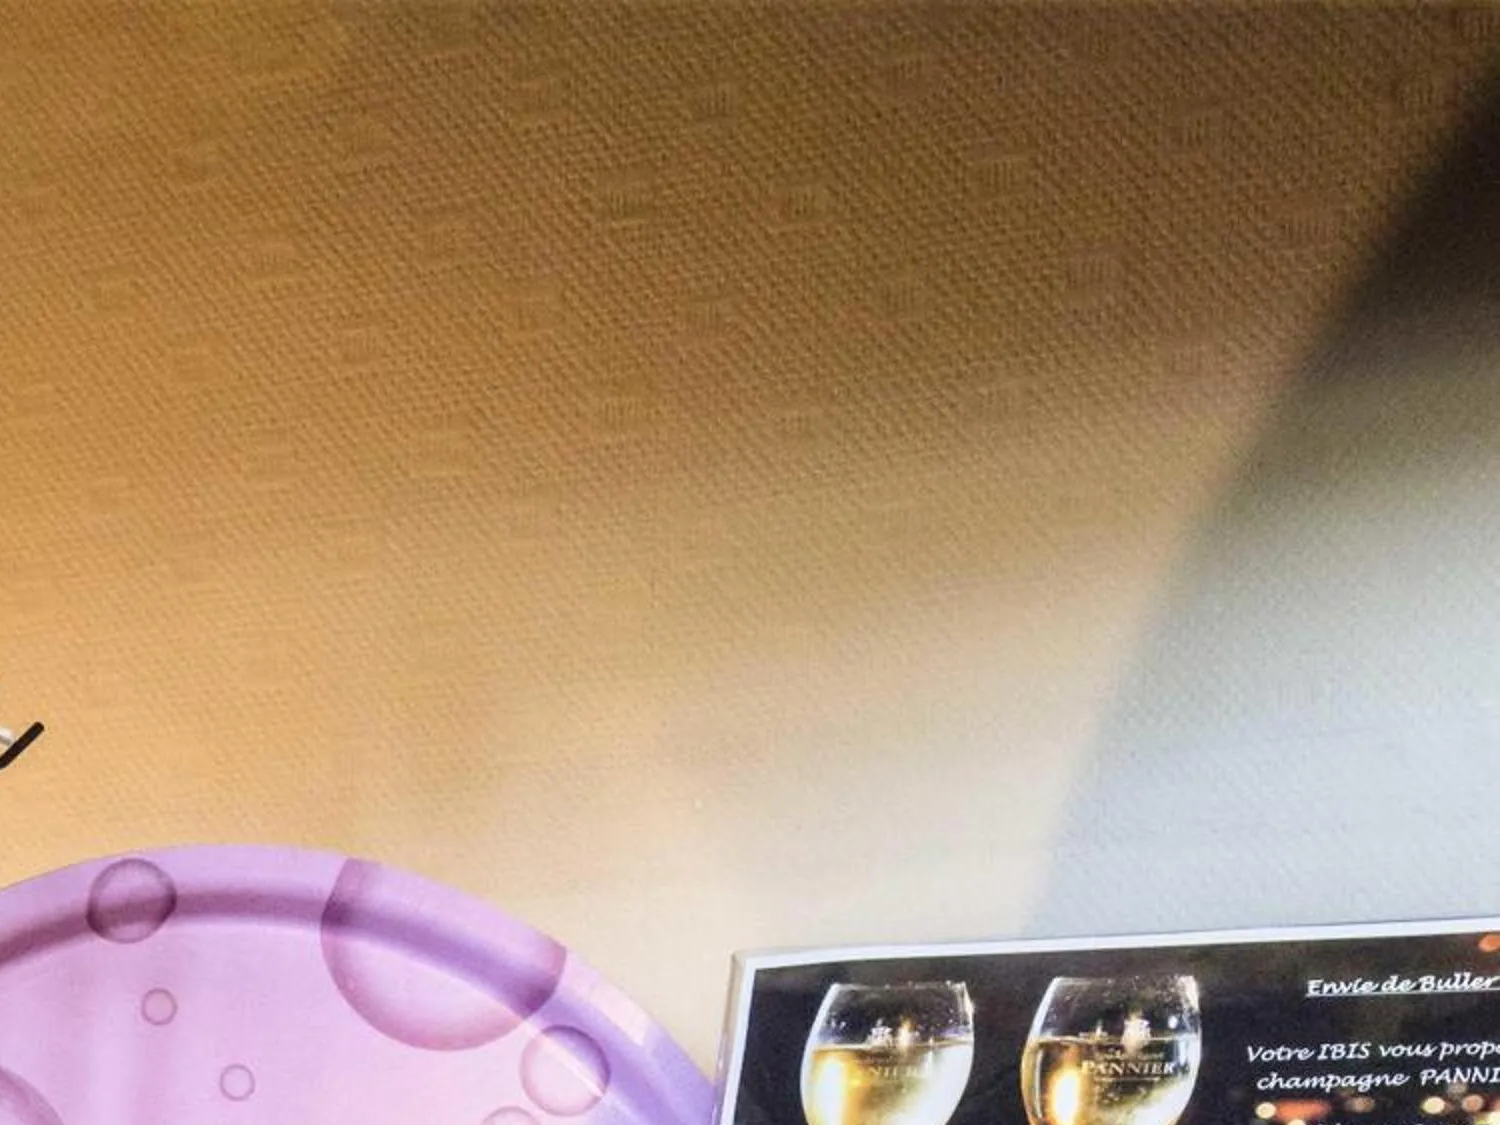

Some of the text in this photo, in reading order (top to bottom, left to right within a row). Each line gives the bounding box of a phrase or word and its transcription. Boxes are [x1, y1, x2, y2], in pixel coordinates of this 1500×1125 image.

[1306, 978, 1379, 996] Envie
[1381, 974, 1416, 993] de
[1248, 1044, 1314, 1062] Votre
[1317, 1042, 1371, 1060] IBIS
[1379, 1043, 1438, 1058] vous
[1257, 1070, 1411, 1093] champagne
